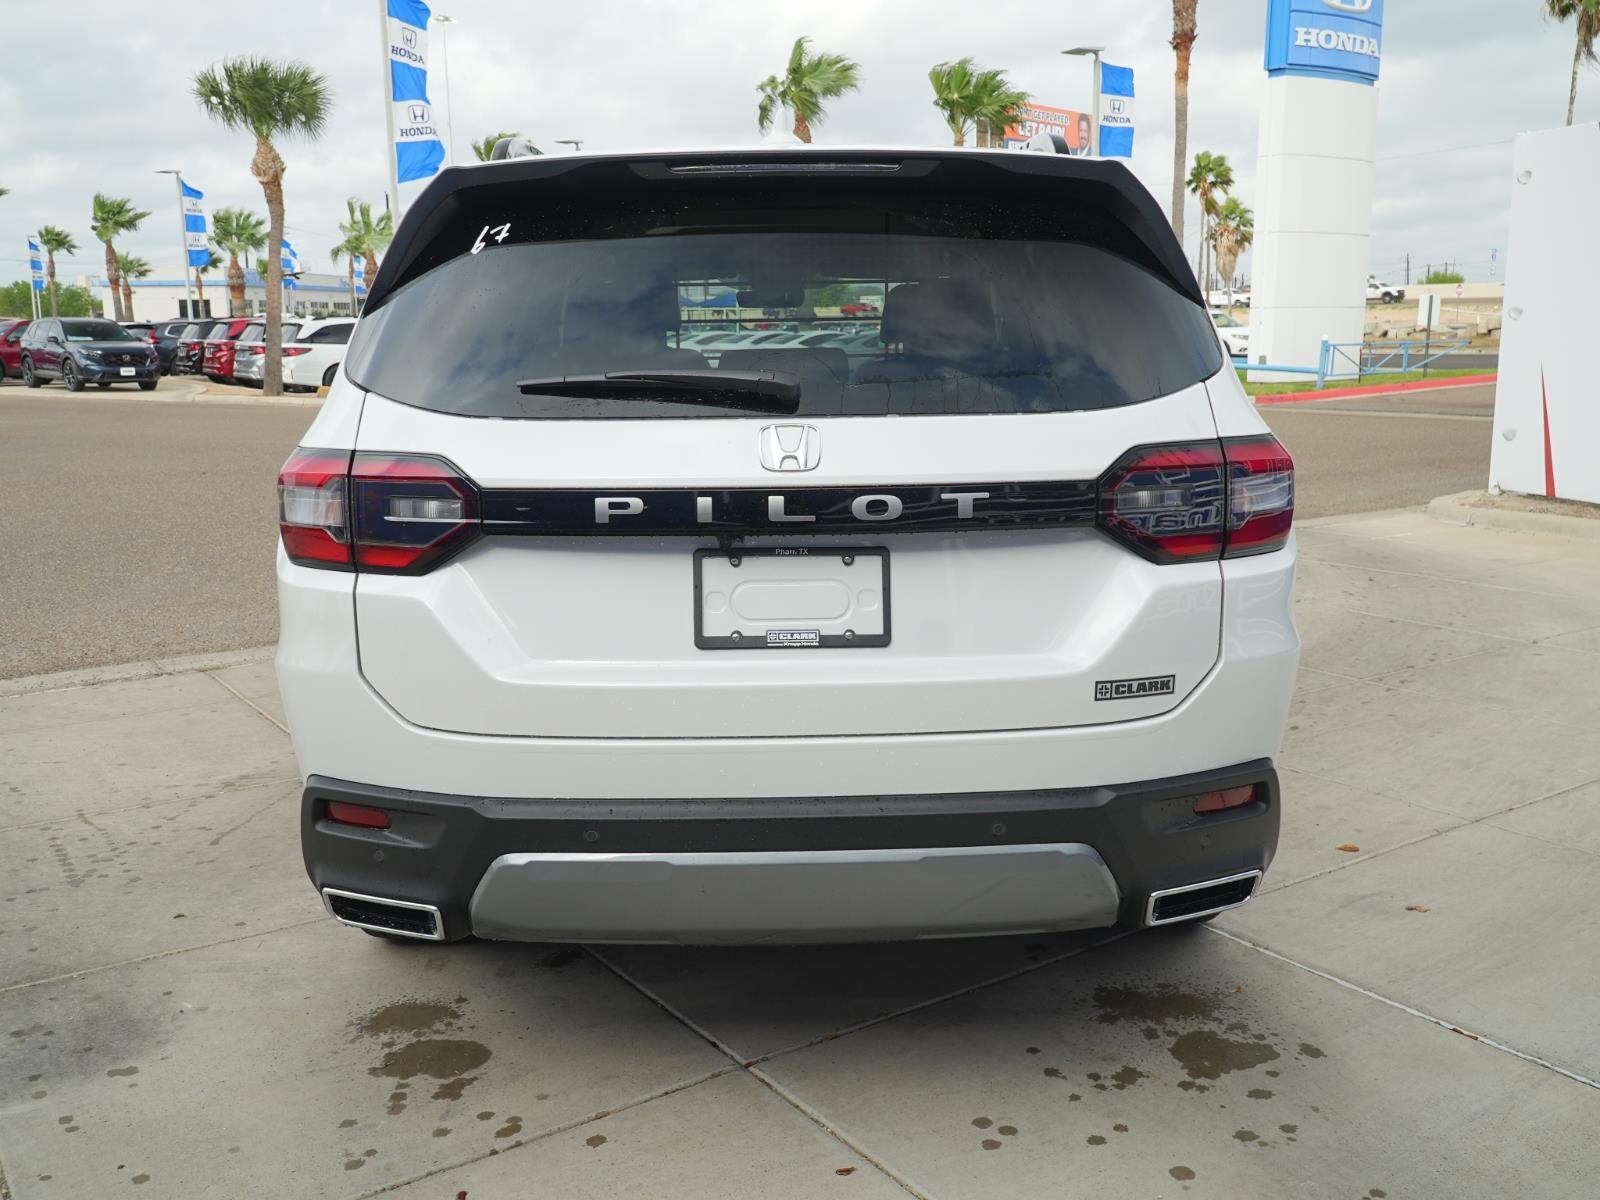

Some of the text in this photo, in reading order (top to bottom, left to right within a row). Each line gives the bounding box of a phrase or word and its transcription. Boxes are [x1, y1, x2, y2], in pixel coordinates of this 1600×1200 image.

[1294, 27, 1380, 59] HONDA
[391, 45, 425, 64] HONDA
[1103, 115, 1131, 123] HONDA
[594, 492, 990, 524] PILOT
[779, 632, 817, 640] CLARK
[1114, 680, 1171, 696] CLARK
